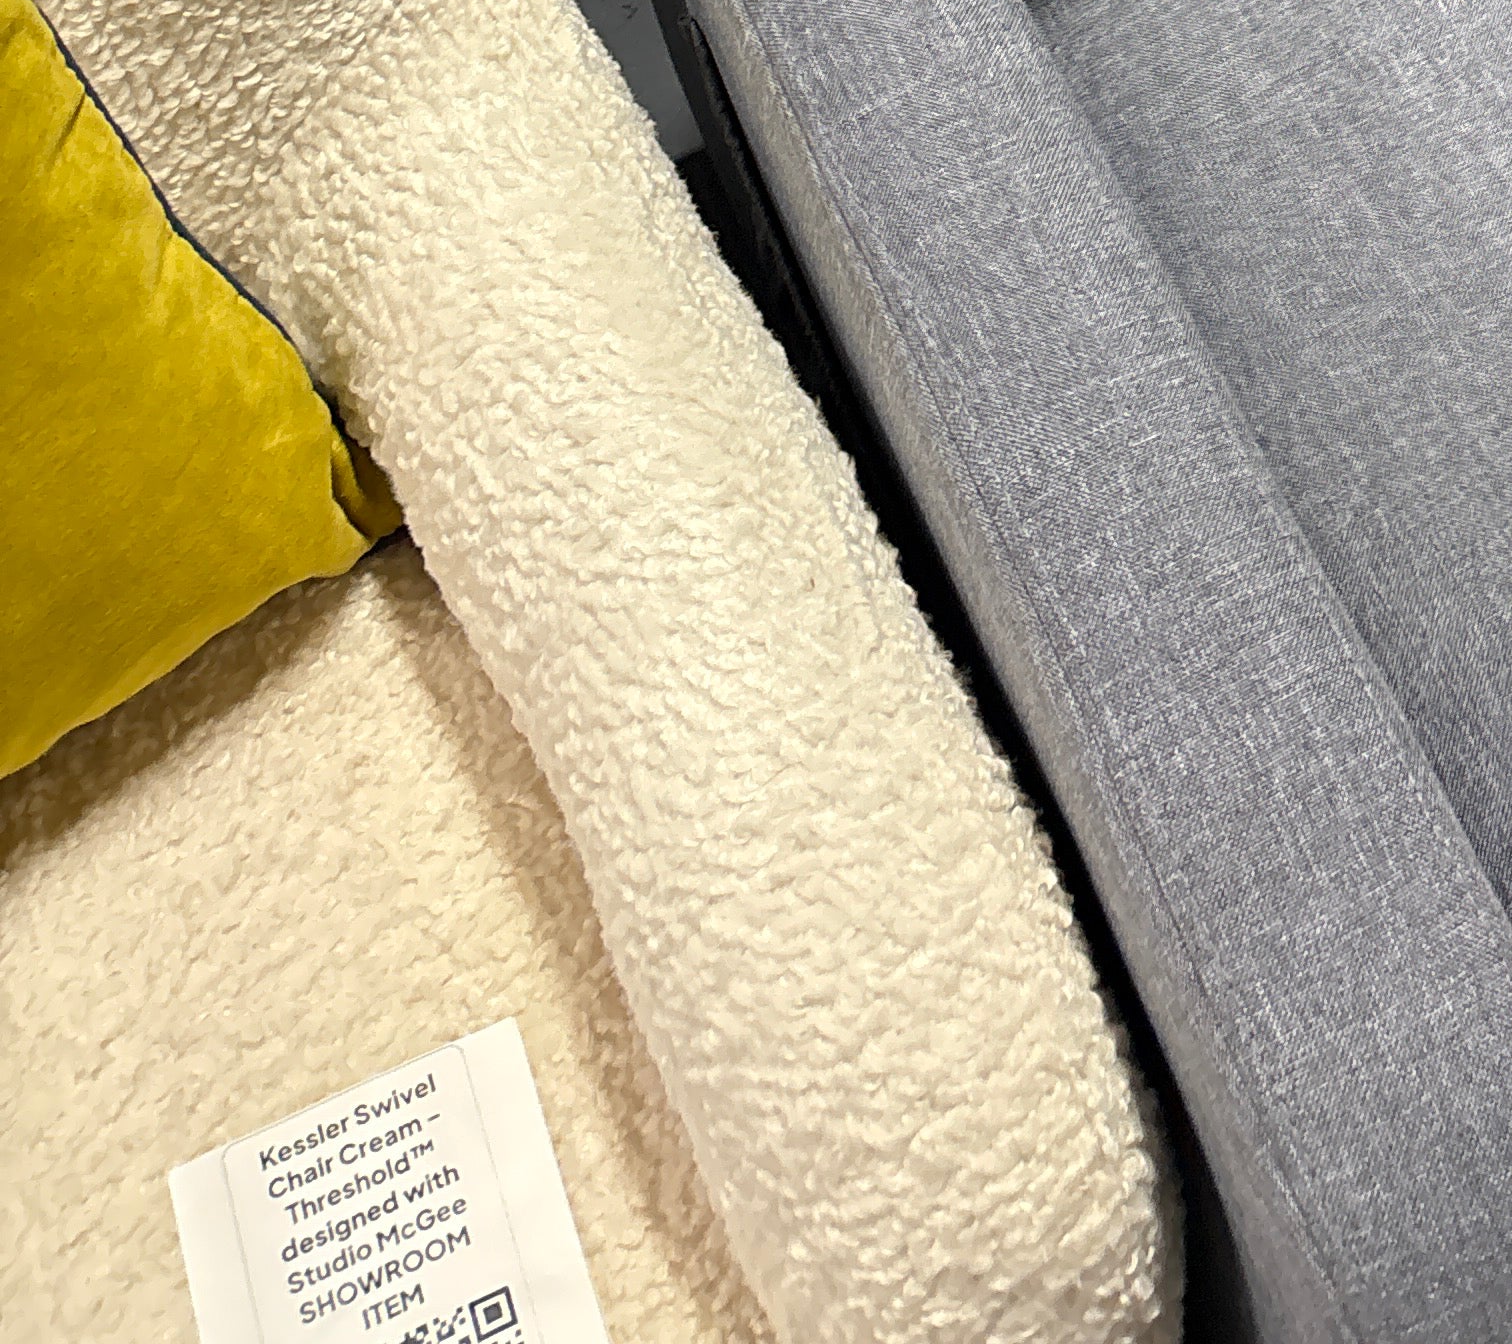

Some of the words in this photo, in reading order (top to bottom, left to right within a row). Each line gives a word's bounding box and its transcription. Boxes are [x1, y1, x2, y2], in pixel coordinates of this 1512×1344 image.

[259, 1116, 349, 1171] Kessler
[353, 1073, 437, 1125] Swivel
[268, 1156, 334, 1198] Chair
[339, 1117, 423, 1165] Cream
[281, 1190, 399, 1262] designed
[403, 1165, 460, 1203] with
[287, 1243, 373, 1294] Studio
[376, 1198, 468, 1253] McGee
[299, 1225, 471, 1324] SHOWROOM
[361, 1283, 425, 1330] ITEM
